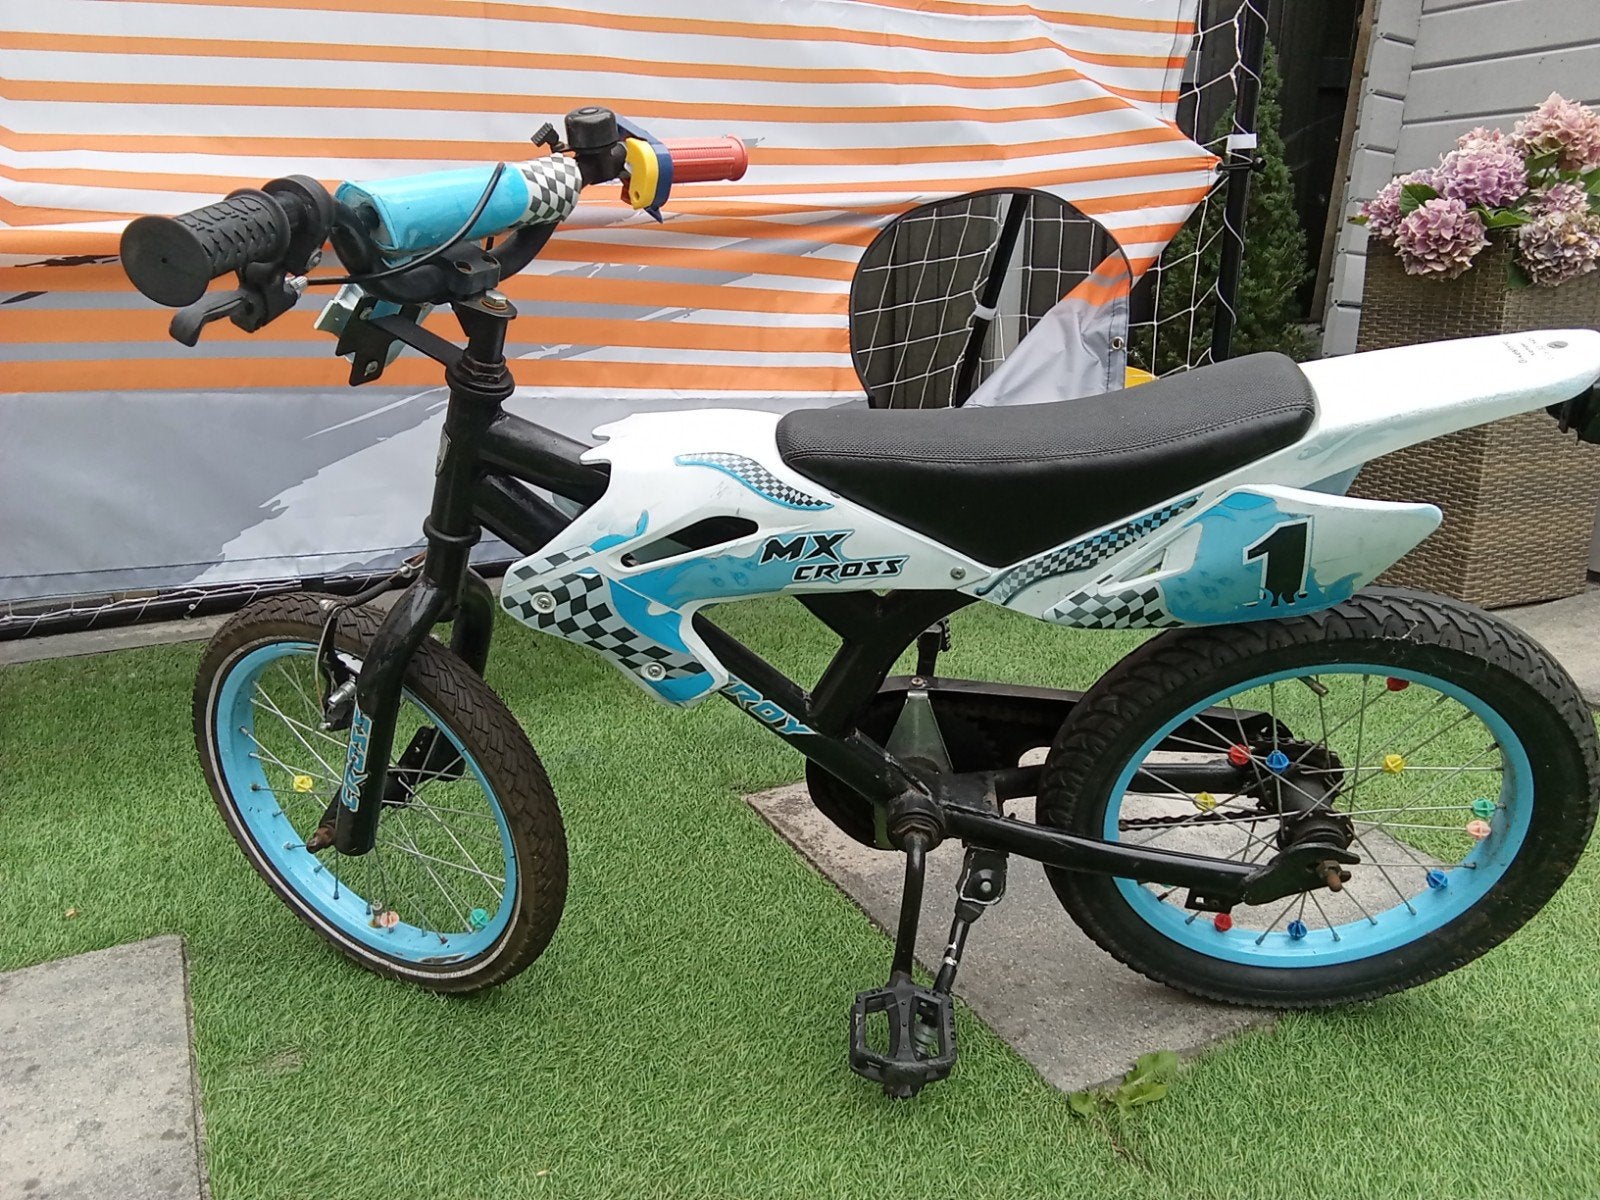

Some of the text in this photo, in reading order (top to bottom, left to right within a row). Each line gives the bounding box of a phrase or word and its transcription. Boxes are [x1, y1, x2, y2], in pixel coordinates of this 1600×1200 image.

[759, 533, 851, 564] MX
[1244, 518, 1311, 607] 1
[793, 559, 904, 582] CROSS
